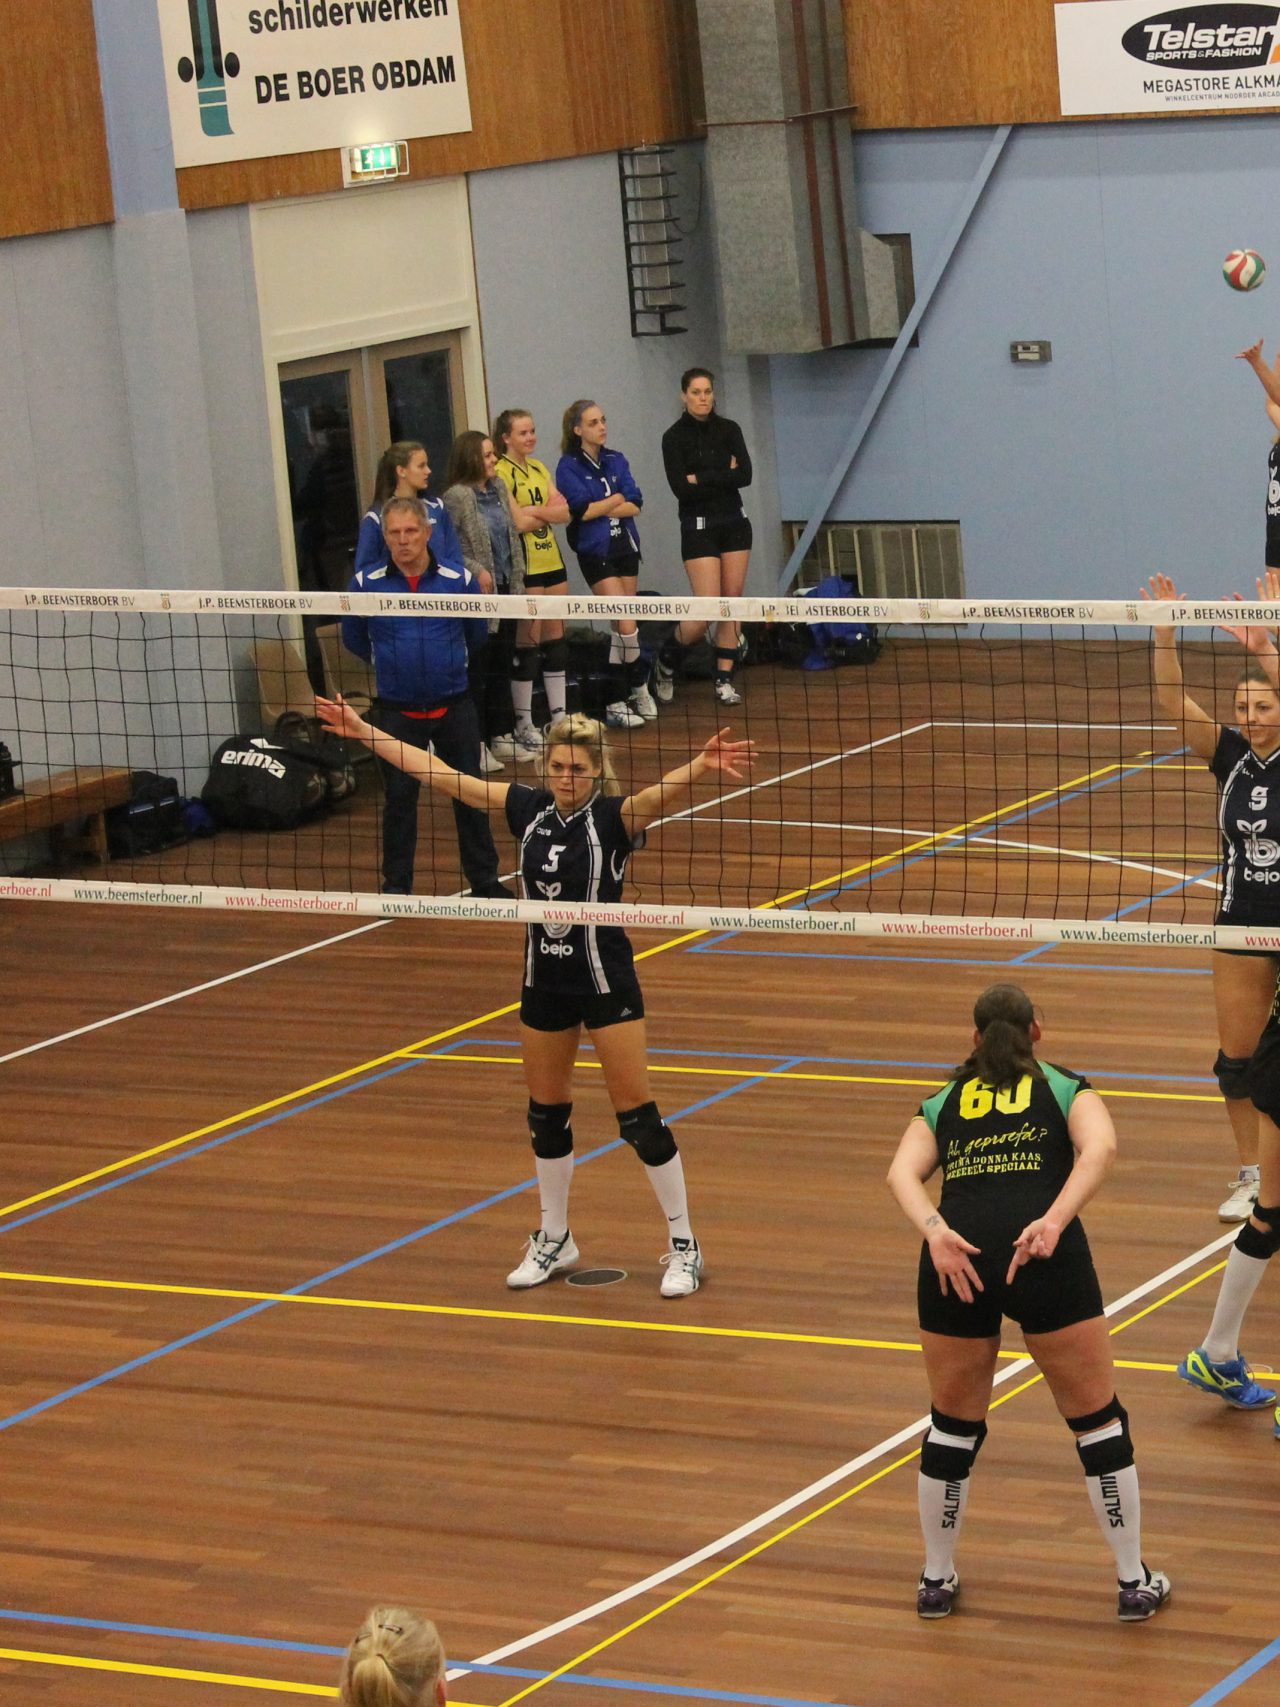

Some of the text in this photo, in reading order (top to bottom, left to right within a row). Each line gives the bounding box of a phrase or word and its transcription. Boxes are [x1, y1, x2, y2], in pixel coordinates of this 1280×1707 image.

[249, 0, 448, 34] schilderwerken
[1143, 22, 1277, 51] Telstar
[255, 55, 456, 104] DE BOER OBDAM
[1143, 76, 1230, 94] MEGASTORE
[1165, 94, 1223, 102] WINKELCENTRUM
[1224, 92, 1256, 100] NOORDER
[528, 487, 544, 506] 14
[25, 595, 135, 606] J.P. BEEMSTERBOER BV
[199, 598, 313, 609] J.P. BEEMSTERBOER BV
[380, 600, 499, 612] J.P. BEEMSTERBOER BV
[568, 603, 690, 615] J.P. BEEMSTERBOER BV
[874, 606, 888, 617] BV
[962, 607, 1094, 618] J.P. BEEMSTERBOER BV
[1172, 609, 1191, 621] J.P.
[221, 749, 286, 779] erima
[1249, 786, 1269, 811] 9
[542, 844, 567, 872] 5
[1244, 867, 1280, 885] bejo
[74, 886, 202, 905] www.beemsterboer.nl
[225, 893, 358, 912] www.beemsterboer.nl
[381, 899, 519, 919] www.beemsterboer.nl
[543, 906, 684, 928] www.beemsterboer.nl
[710, 913, 856, 932] www.beemsterboer.nl
[882, 920, 1033, 939] www.beemsterboer.nl
[1060, 925, 1217, 945] www.beemsterboer.nl
[540, 938, 573, 959] bejo
[959, 1073, 1033, 1120] 60
[973, 1153, 1008, 1165] DONNA
[986, 1161, 1041, 1173] SPECIAAL
